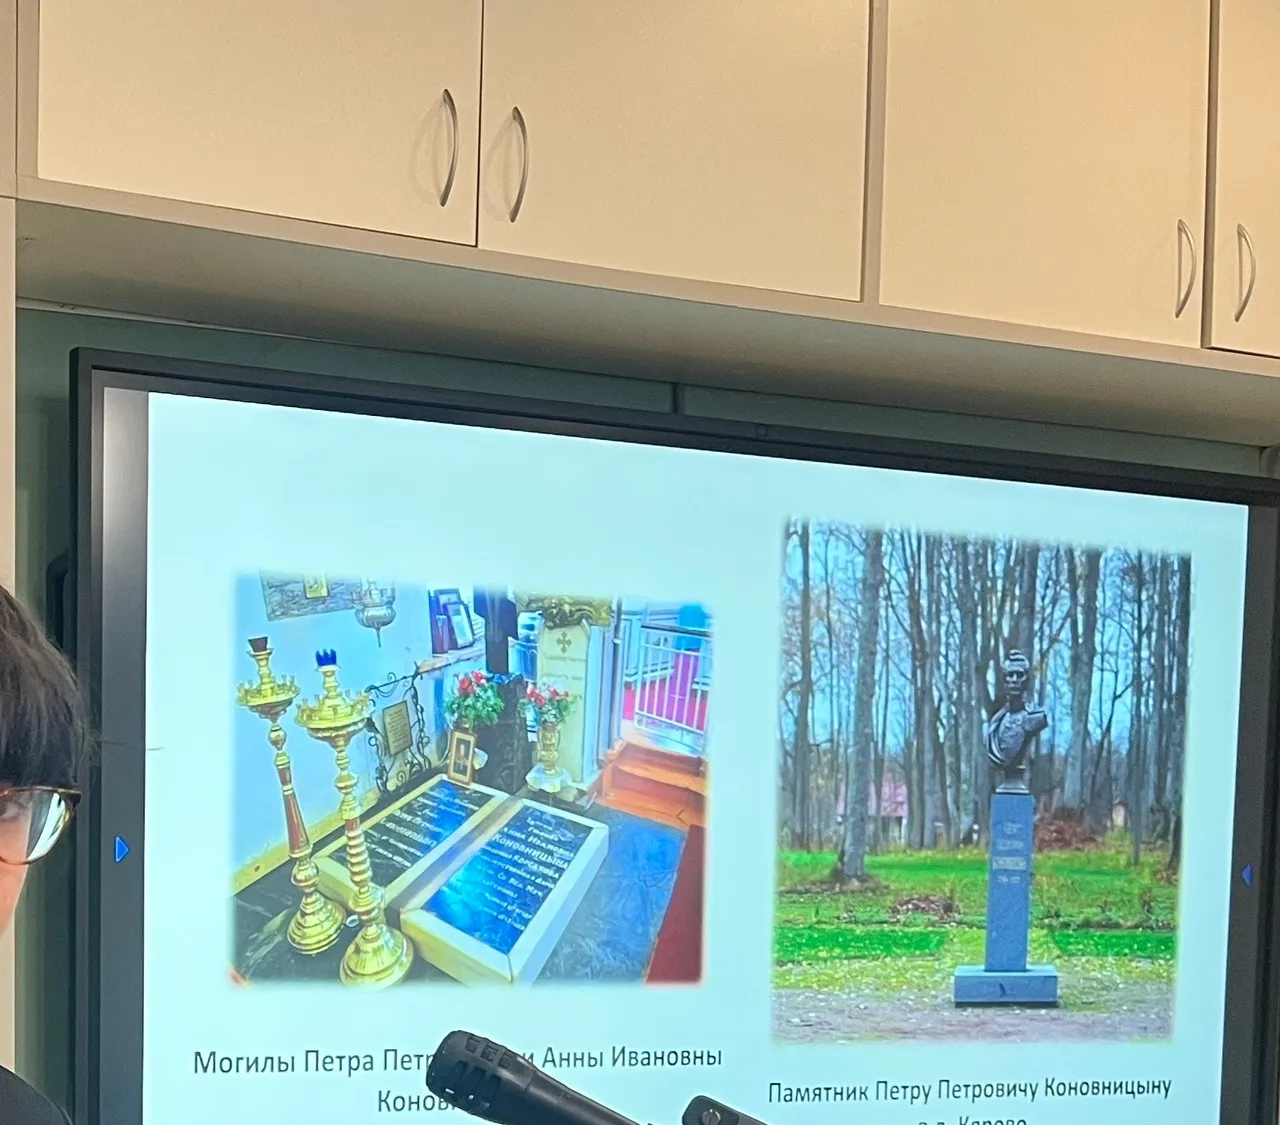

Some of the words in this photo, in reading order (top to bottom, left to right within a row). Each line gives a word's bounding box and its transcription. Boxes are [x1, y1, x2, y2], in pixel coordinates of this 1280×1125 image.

[194, 1051, 295, 1074] Могилы
[305, 1050, 374, 1077] Петра
[542, 1047, 603, 1068] Анны
[612, 1046, 722, 1068] Ивановны
[769, 1082, 869, 1103] Памятник
[876, 1081, 932, 1105] Петру
[938, 1079, 1039, 1103] Петровичу
[1044, 1077, 1172, 1100] Коновницыну
